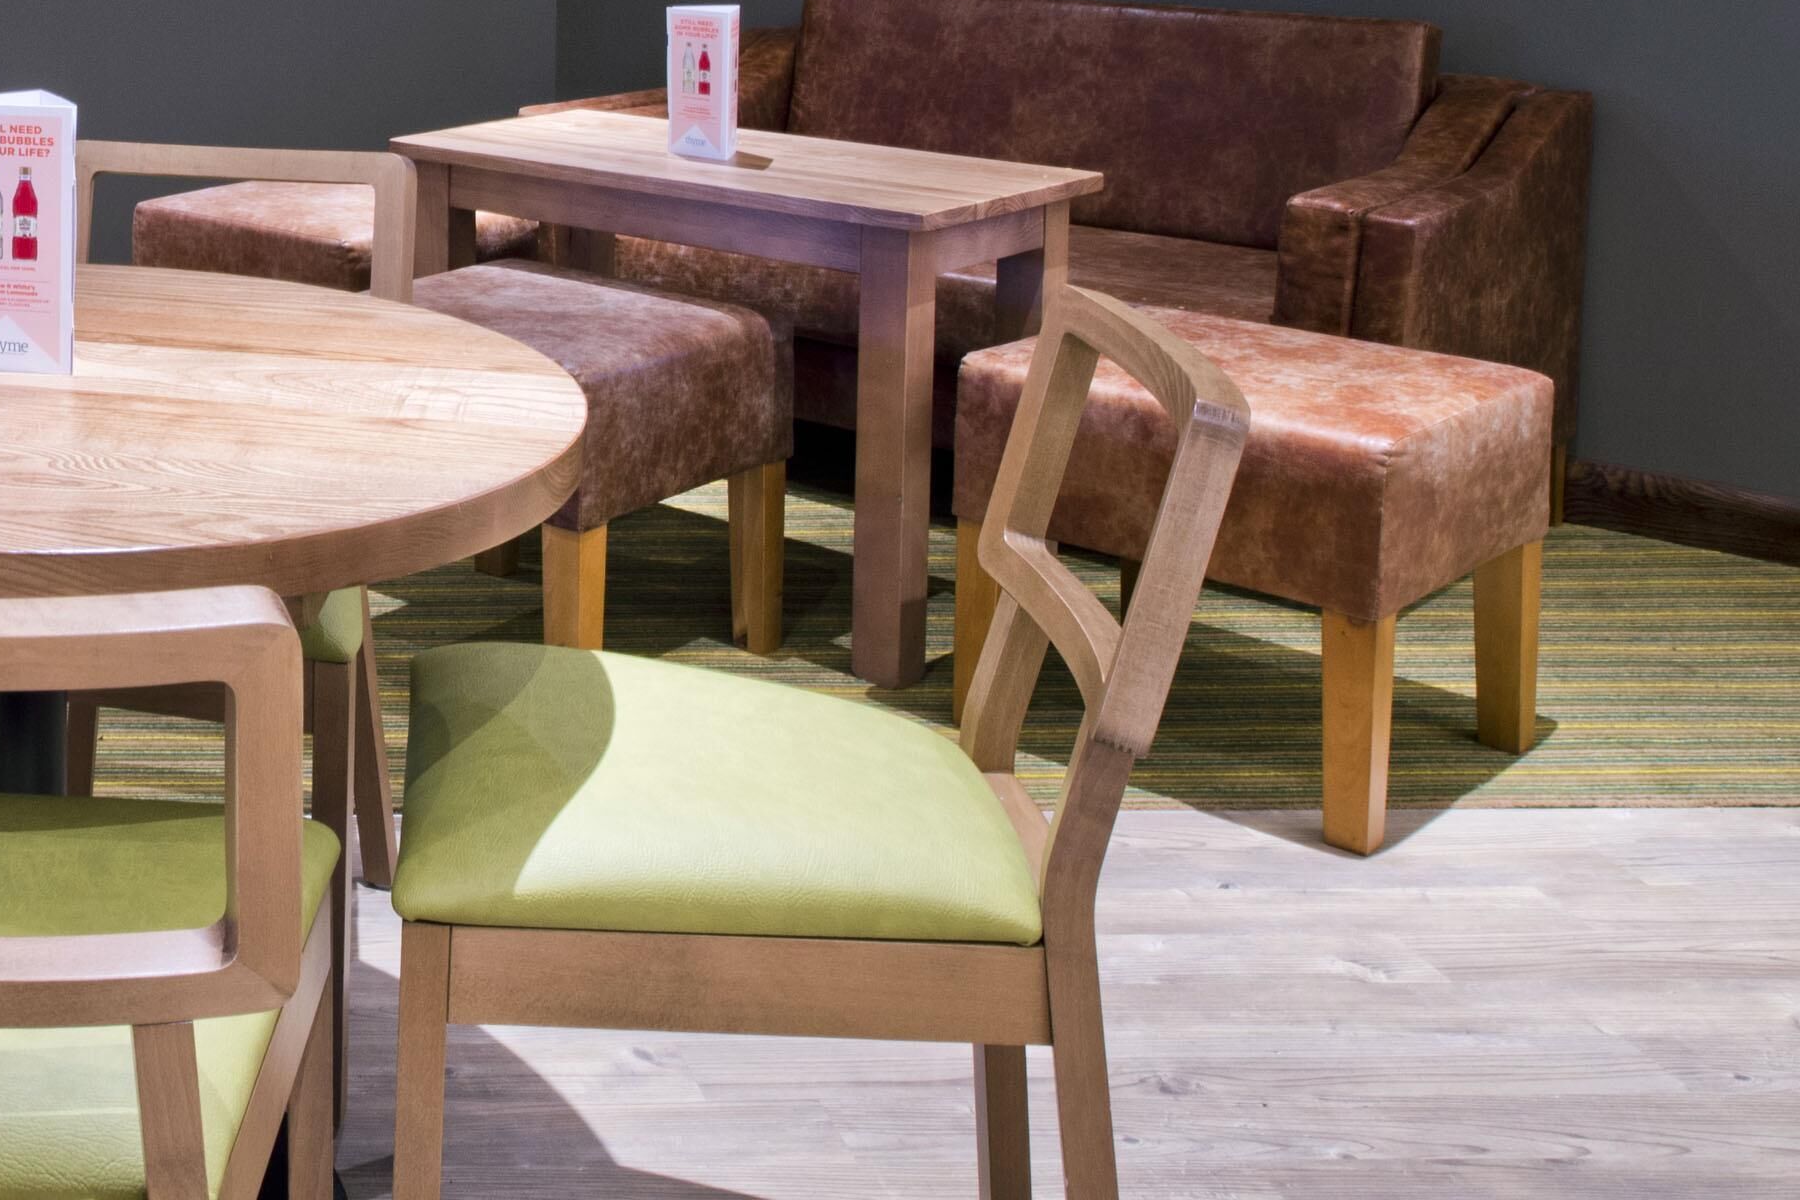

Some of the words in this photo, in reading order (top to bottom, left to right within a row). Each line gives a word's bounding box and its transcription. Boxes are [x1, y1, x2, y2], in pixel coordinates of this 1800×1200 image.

[9, 125, 42, 135] NEED
[0, 135, 54, 146] BUBBLES
[18, 147, 50, 158] LIFE?
